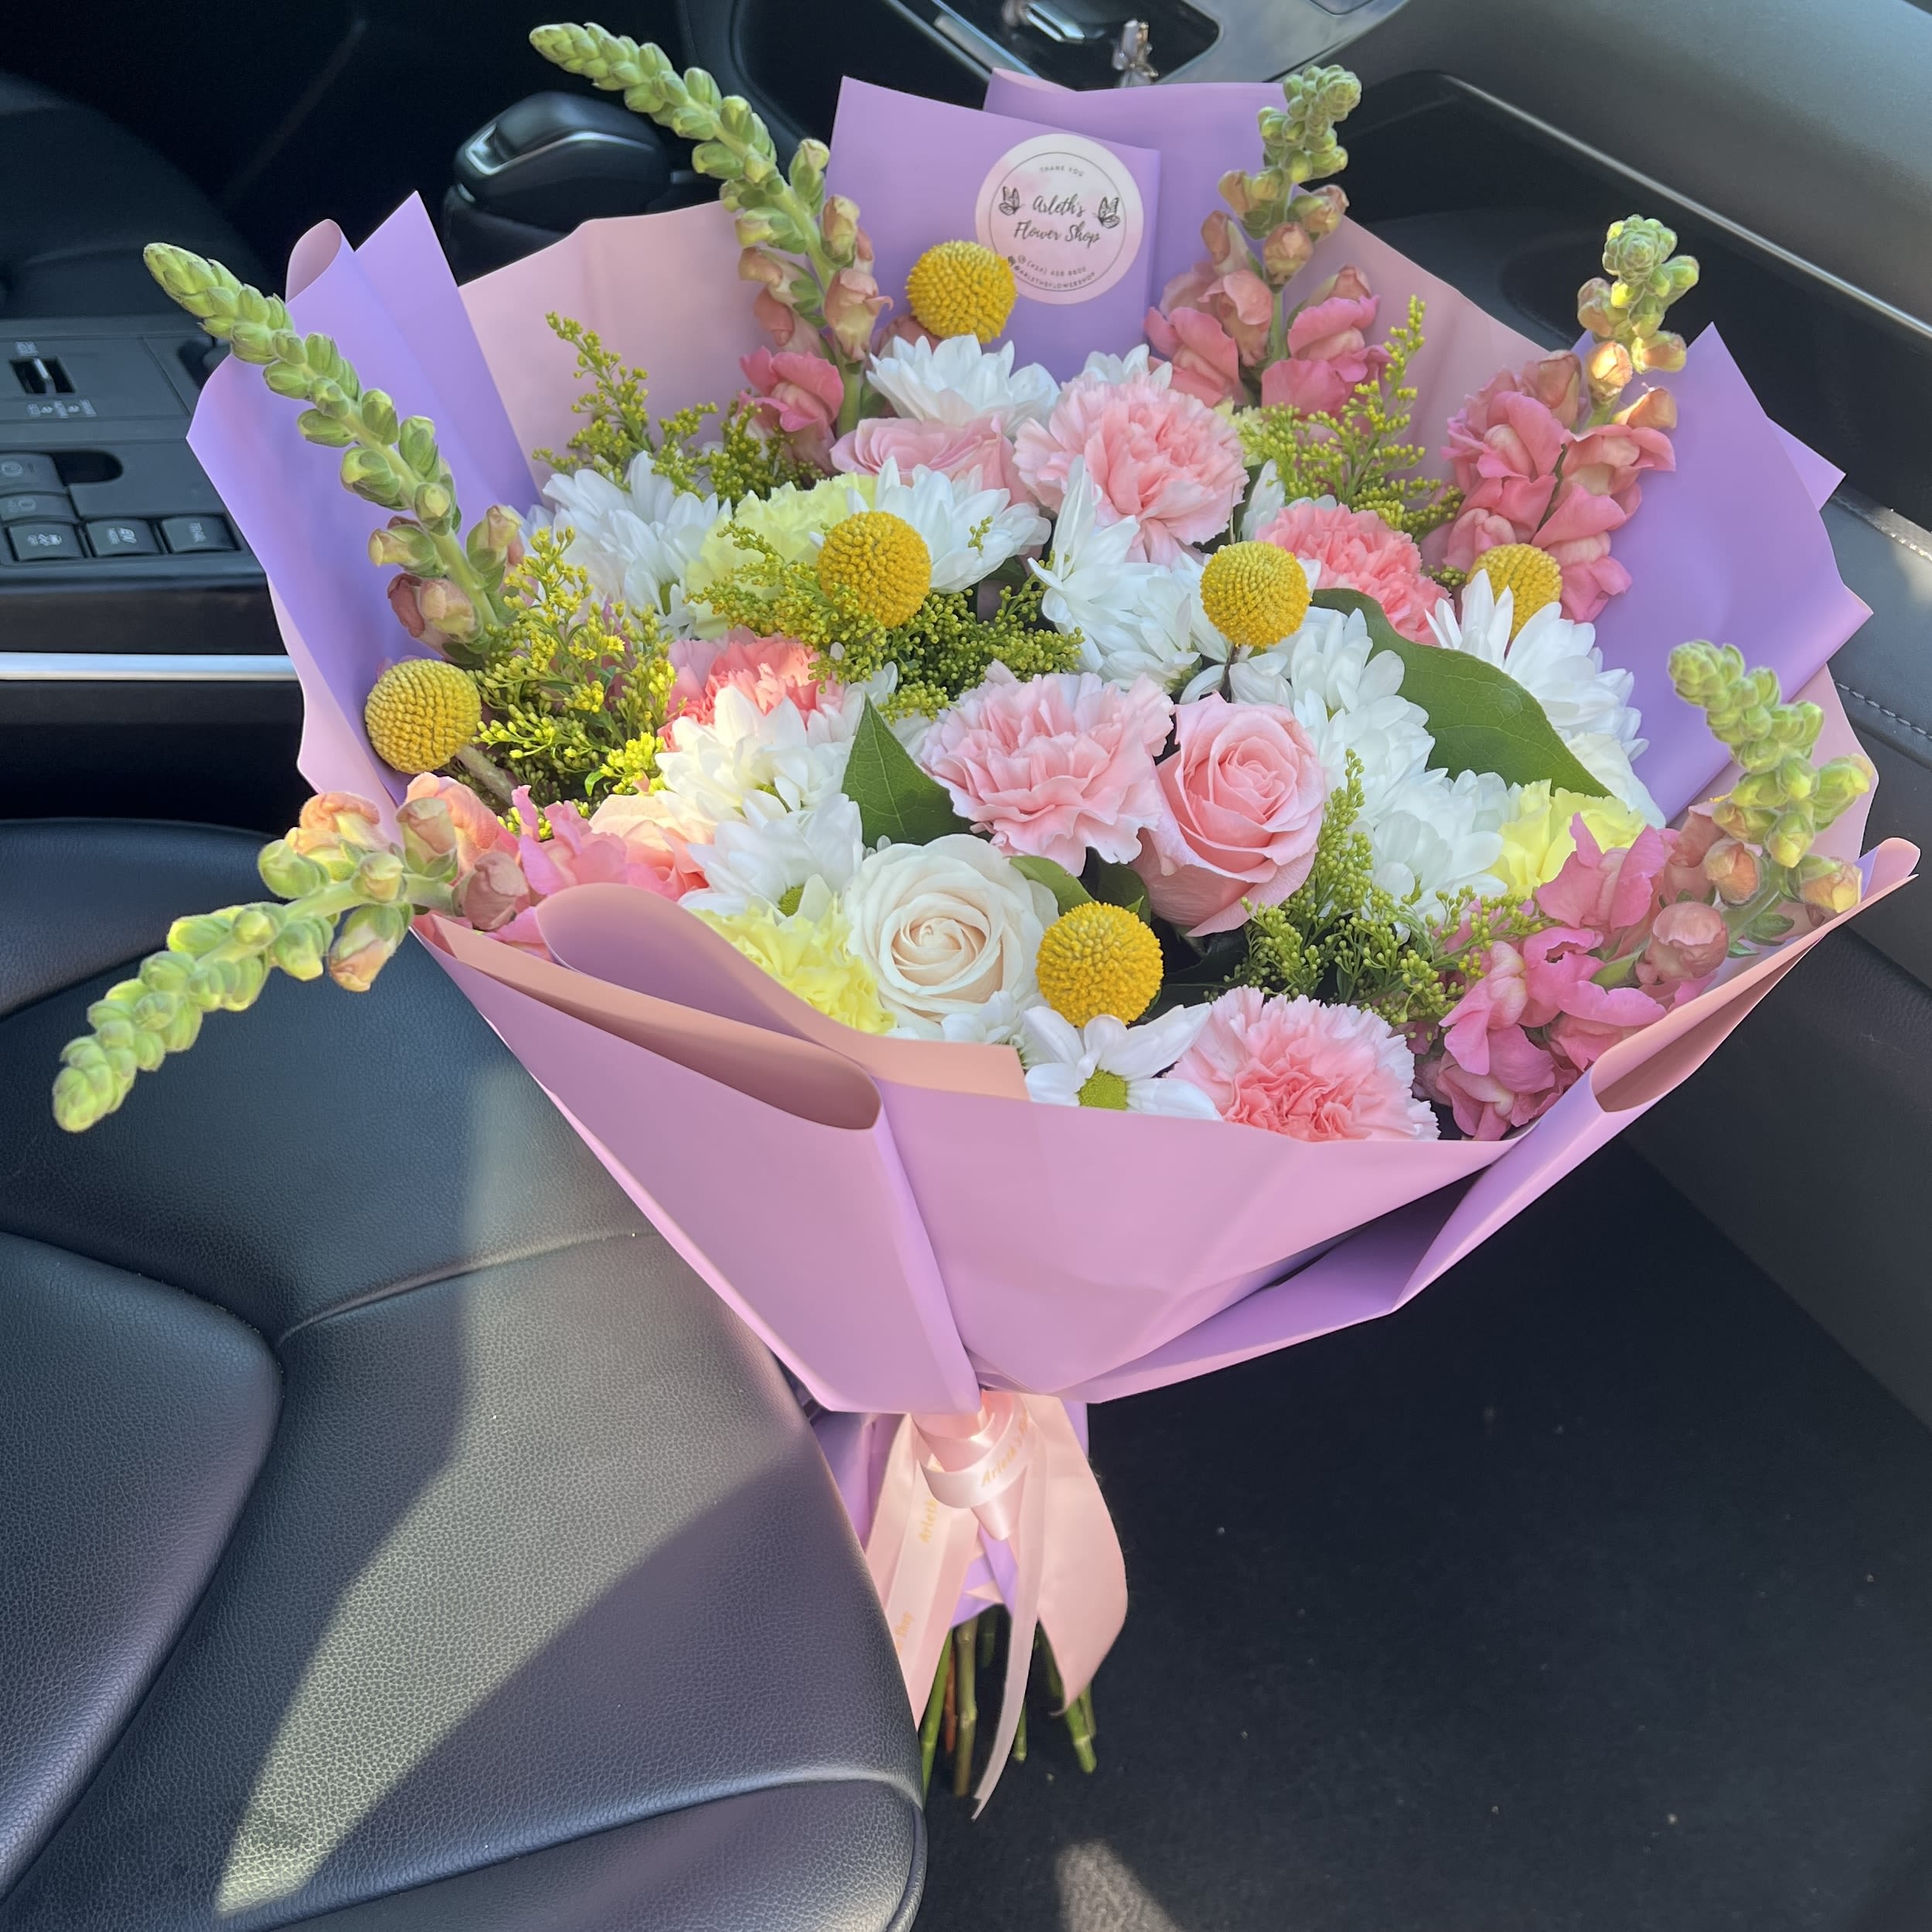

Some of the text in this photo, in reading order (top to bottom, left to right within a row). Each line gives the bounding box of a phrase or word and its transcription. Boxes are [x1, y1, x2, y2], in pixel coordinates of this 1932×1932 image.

[1032, 193, 1085, 217] Arleth's
[1014, 220, 1101, 248] Flower Shop
